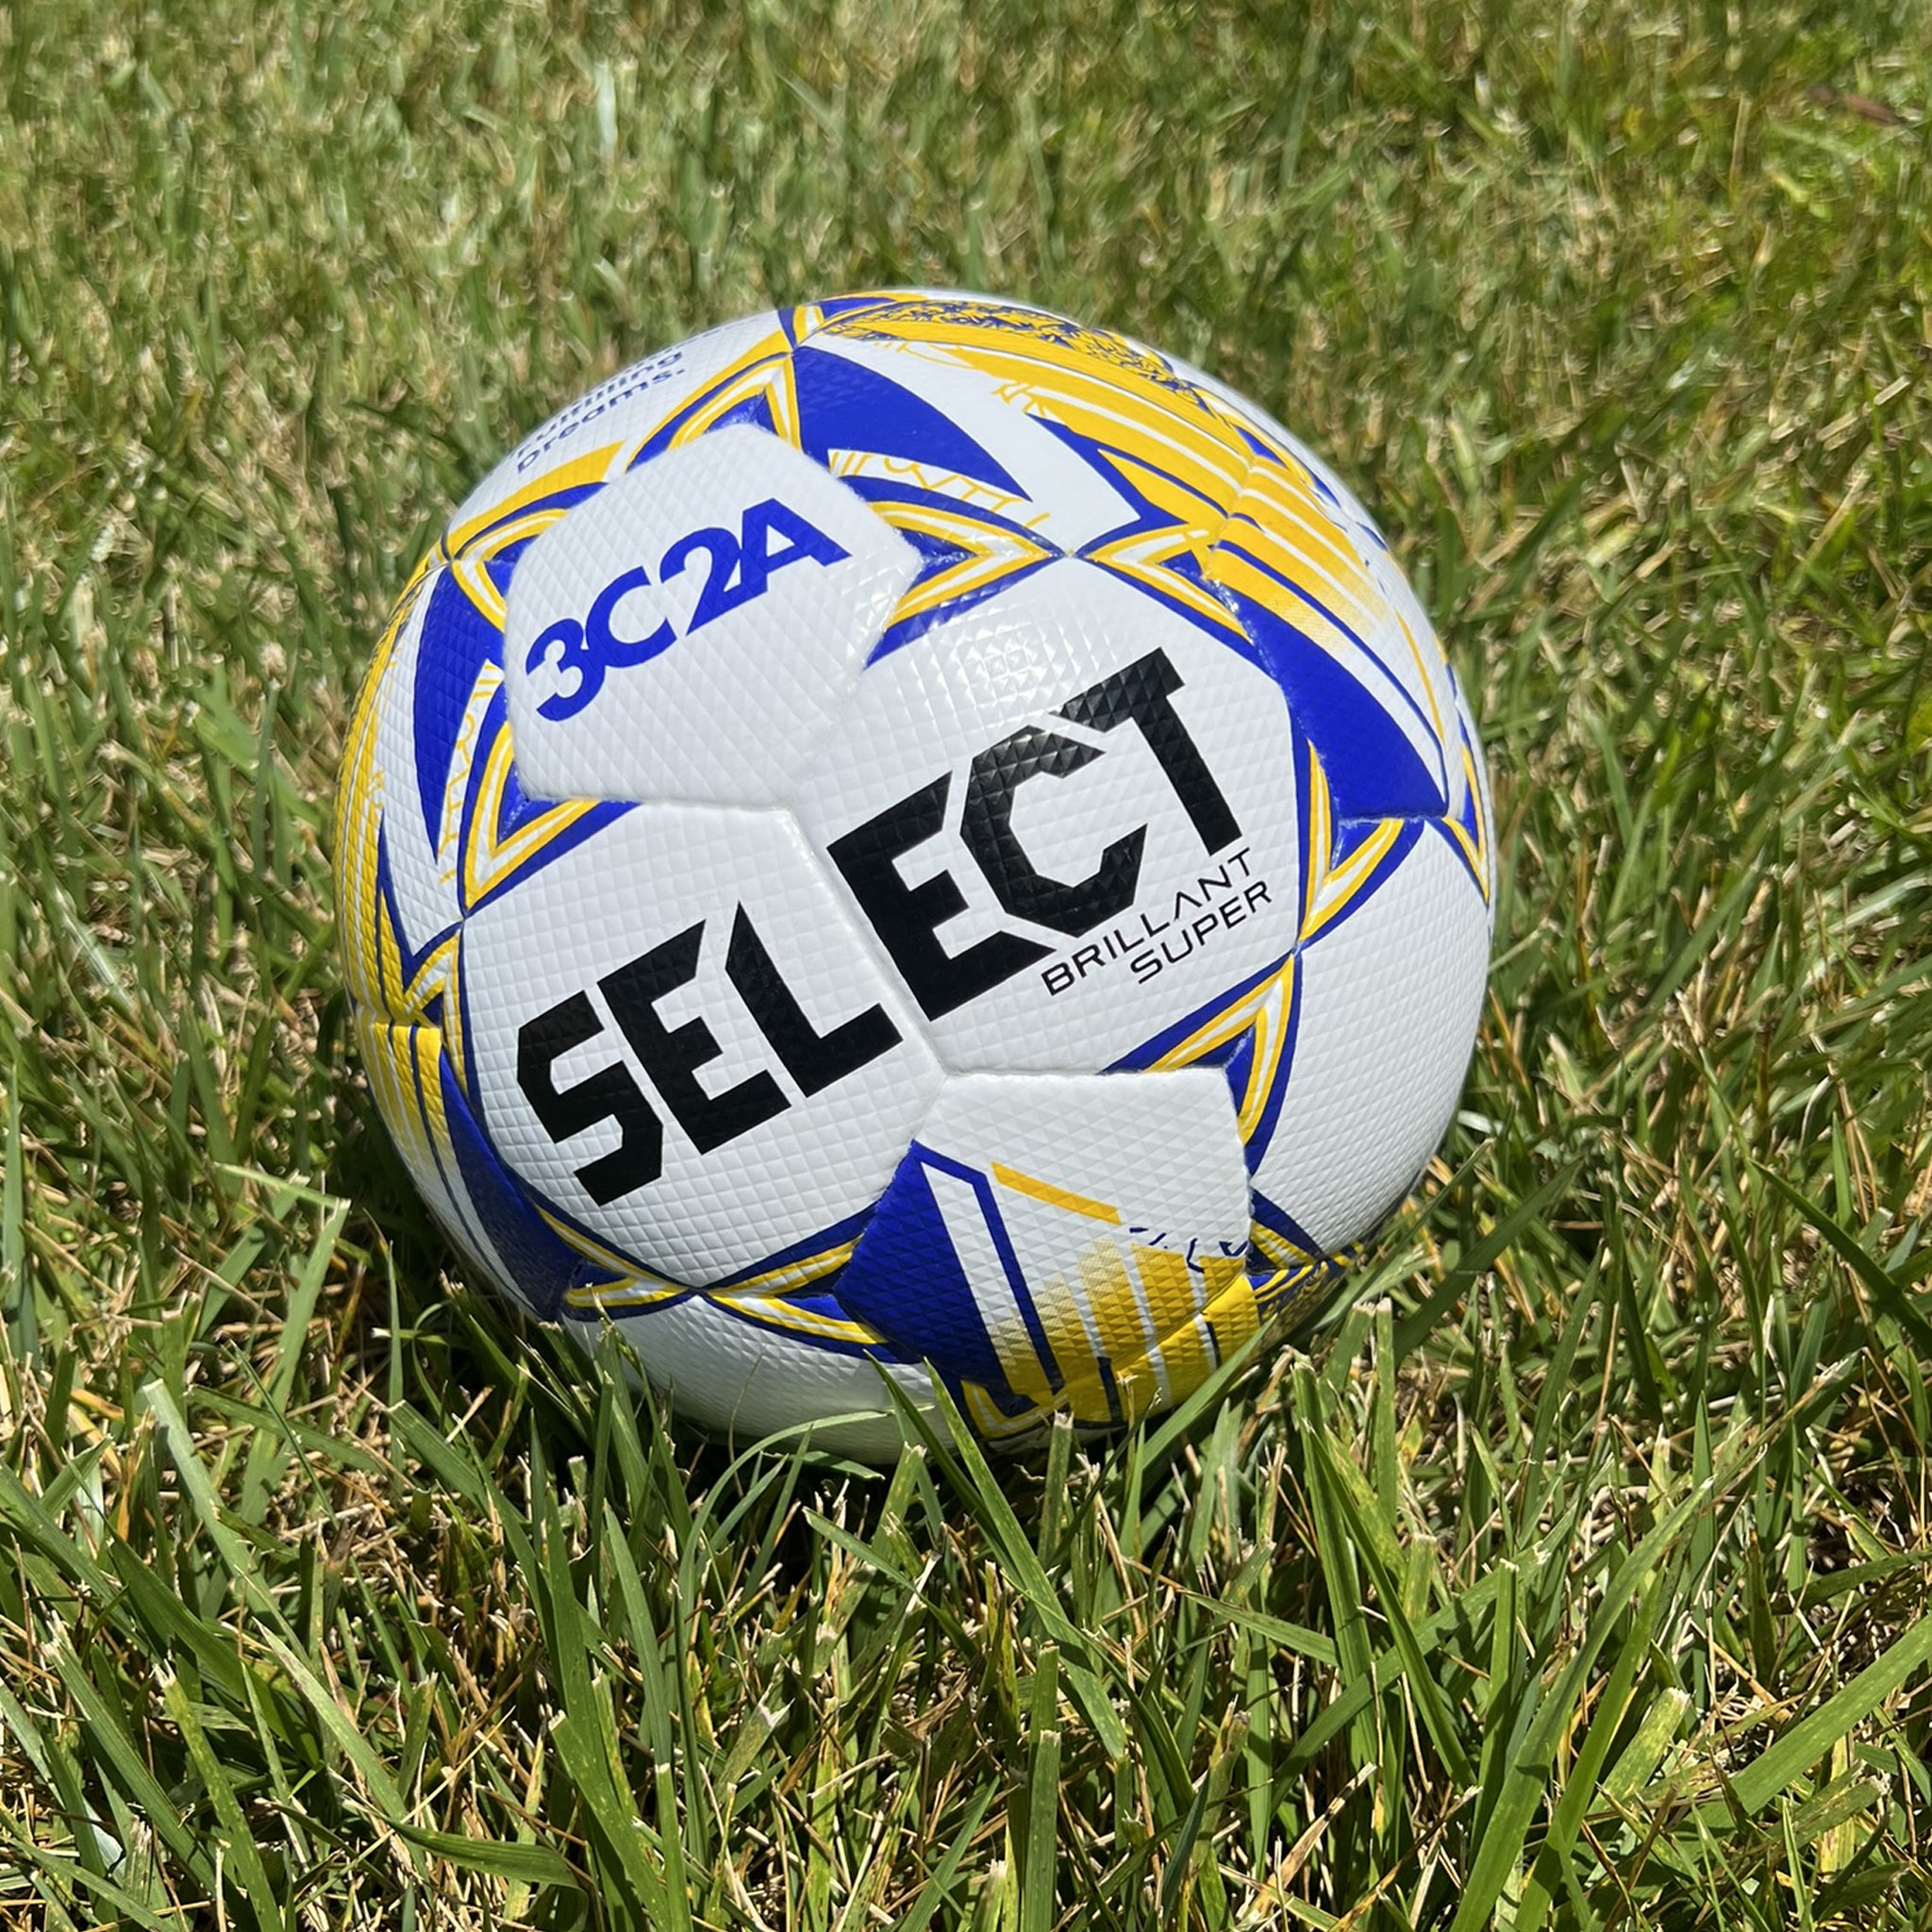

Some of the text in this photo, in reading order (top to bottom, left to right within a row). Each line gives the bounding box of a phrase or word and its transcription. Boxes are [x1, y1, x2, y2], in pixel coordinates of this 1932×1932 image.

[518, 368, 686, 475] Dreams.
[525, 498, 853, 722] 3C2A
[516, 647, 1242, 1207] SELECT
[1041, 847, 1250, 996] BRILLANT
[1130, 880, 1272, 985] SUPER
